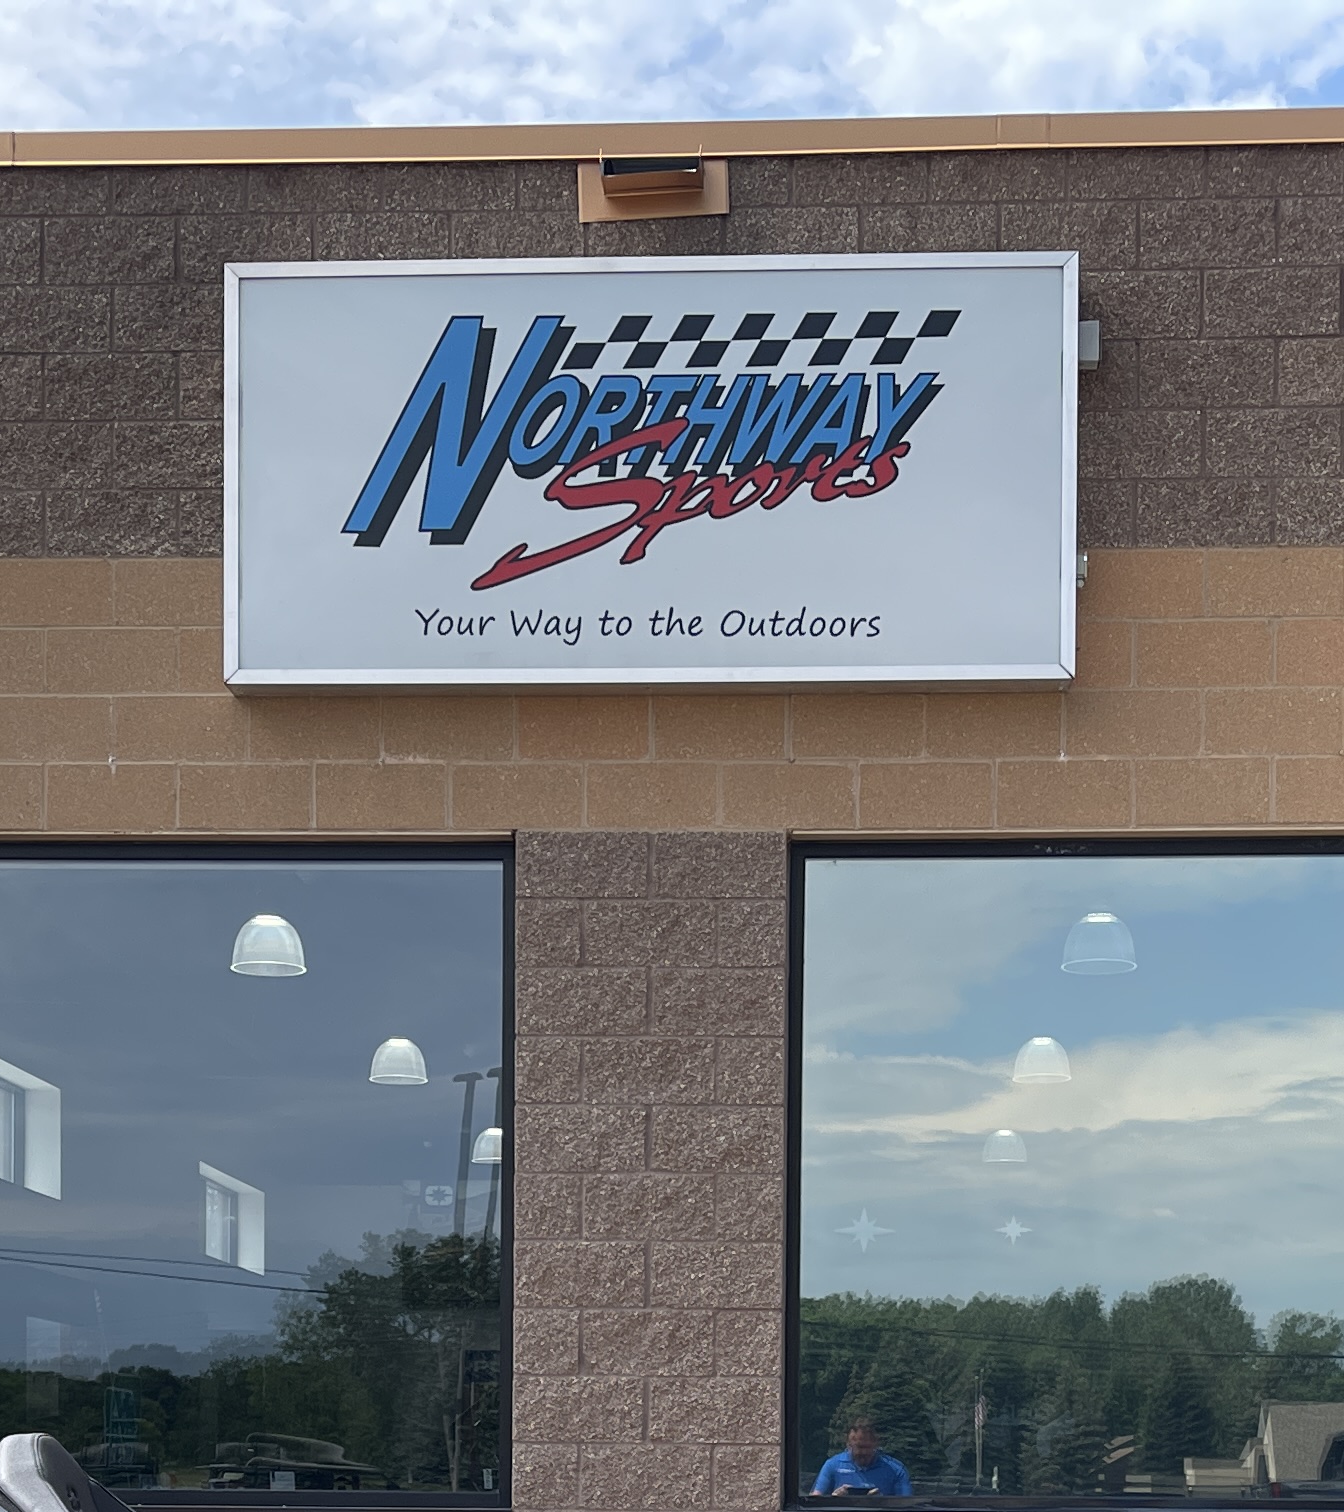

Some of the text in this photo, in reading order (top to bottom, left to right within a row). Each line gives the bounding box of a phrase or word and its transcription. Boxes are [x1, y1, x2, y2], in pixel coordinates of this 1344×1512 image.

[341, 315, 944, 546] NORTHWAY
[470, 418, 911, 590] Sports
[414, 606, 882, 646] Your Way to the Outdoors
